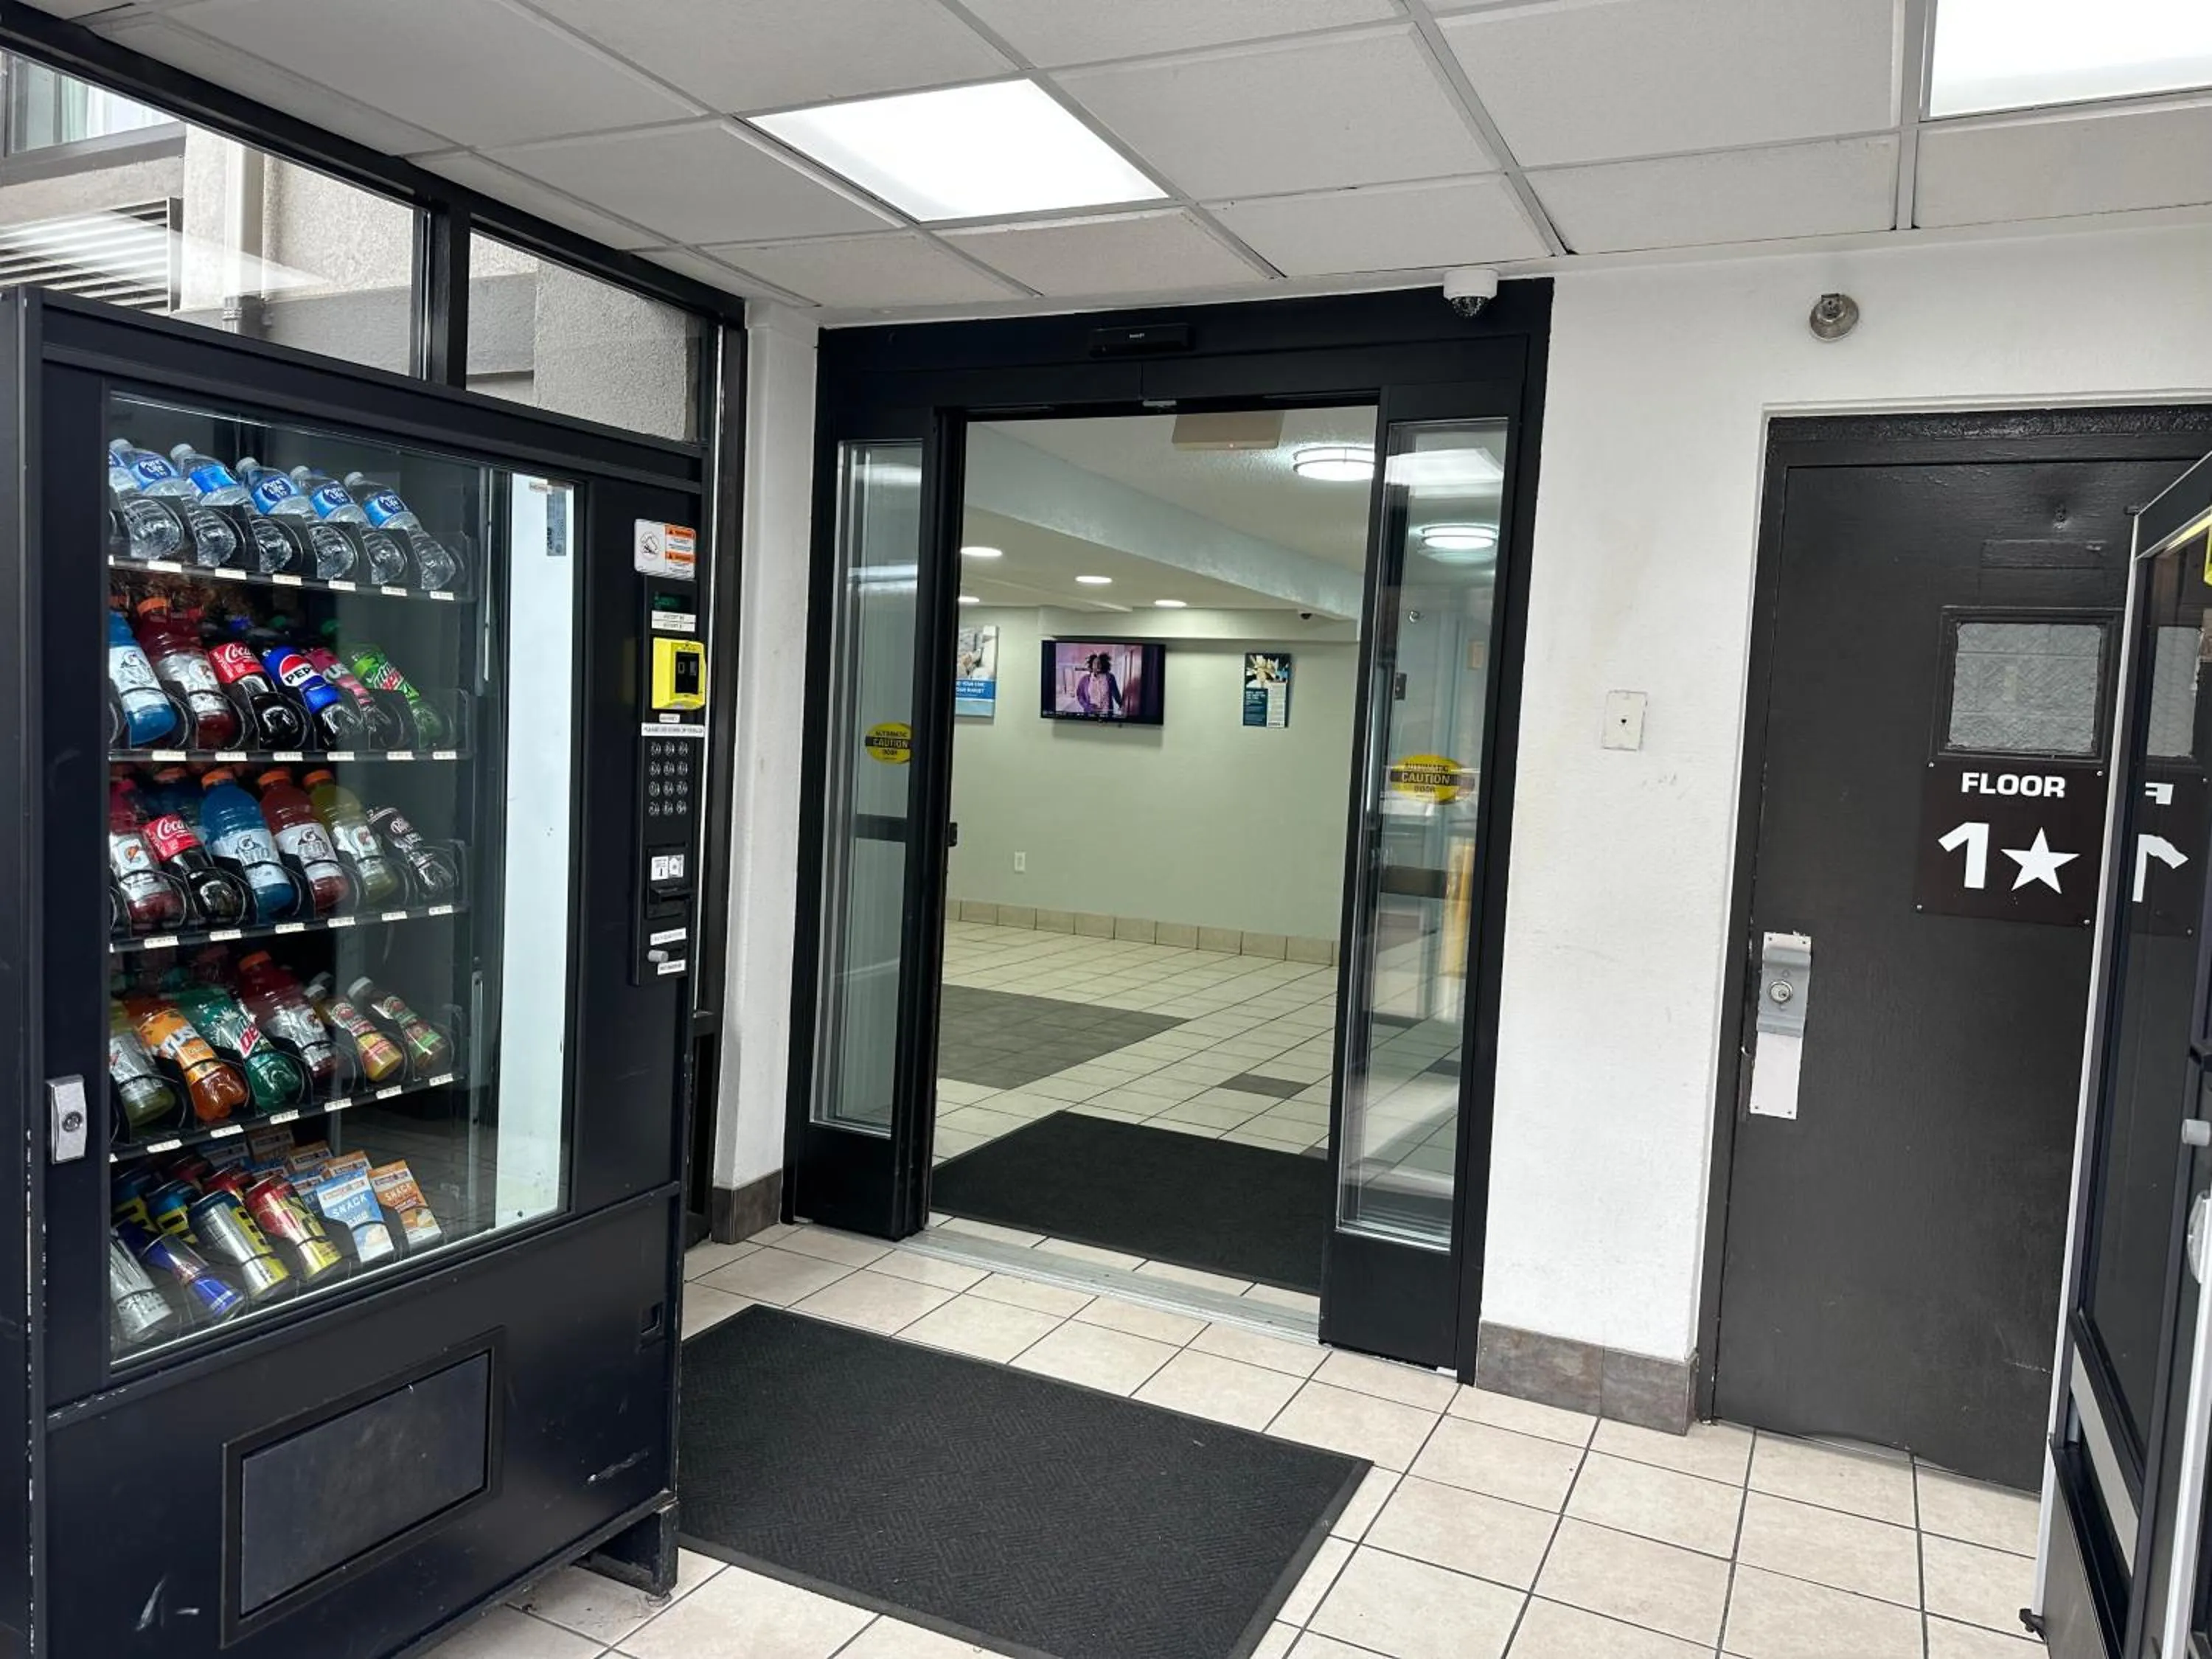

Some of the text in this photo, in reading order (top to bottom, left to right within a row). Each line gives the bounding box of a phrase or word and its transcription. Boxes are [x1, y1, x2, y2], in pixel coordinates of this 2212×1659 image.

[285, 666, 311, 684] PEP
[872, 738, 910, 748] CAUTION
[1401, 773, 1451, 785] CAUTION
[1962, 772, 2065, 798] FLOOR
[1938, 821, 1989, 889] 1
[384, 1183, 412, 1201] SNACK
[332, 1193, 369, 1217] SNACK
